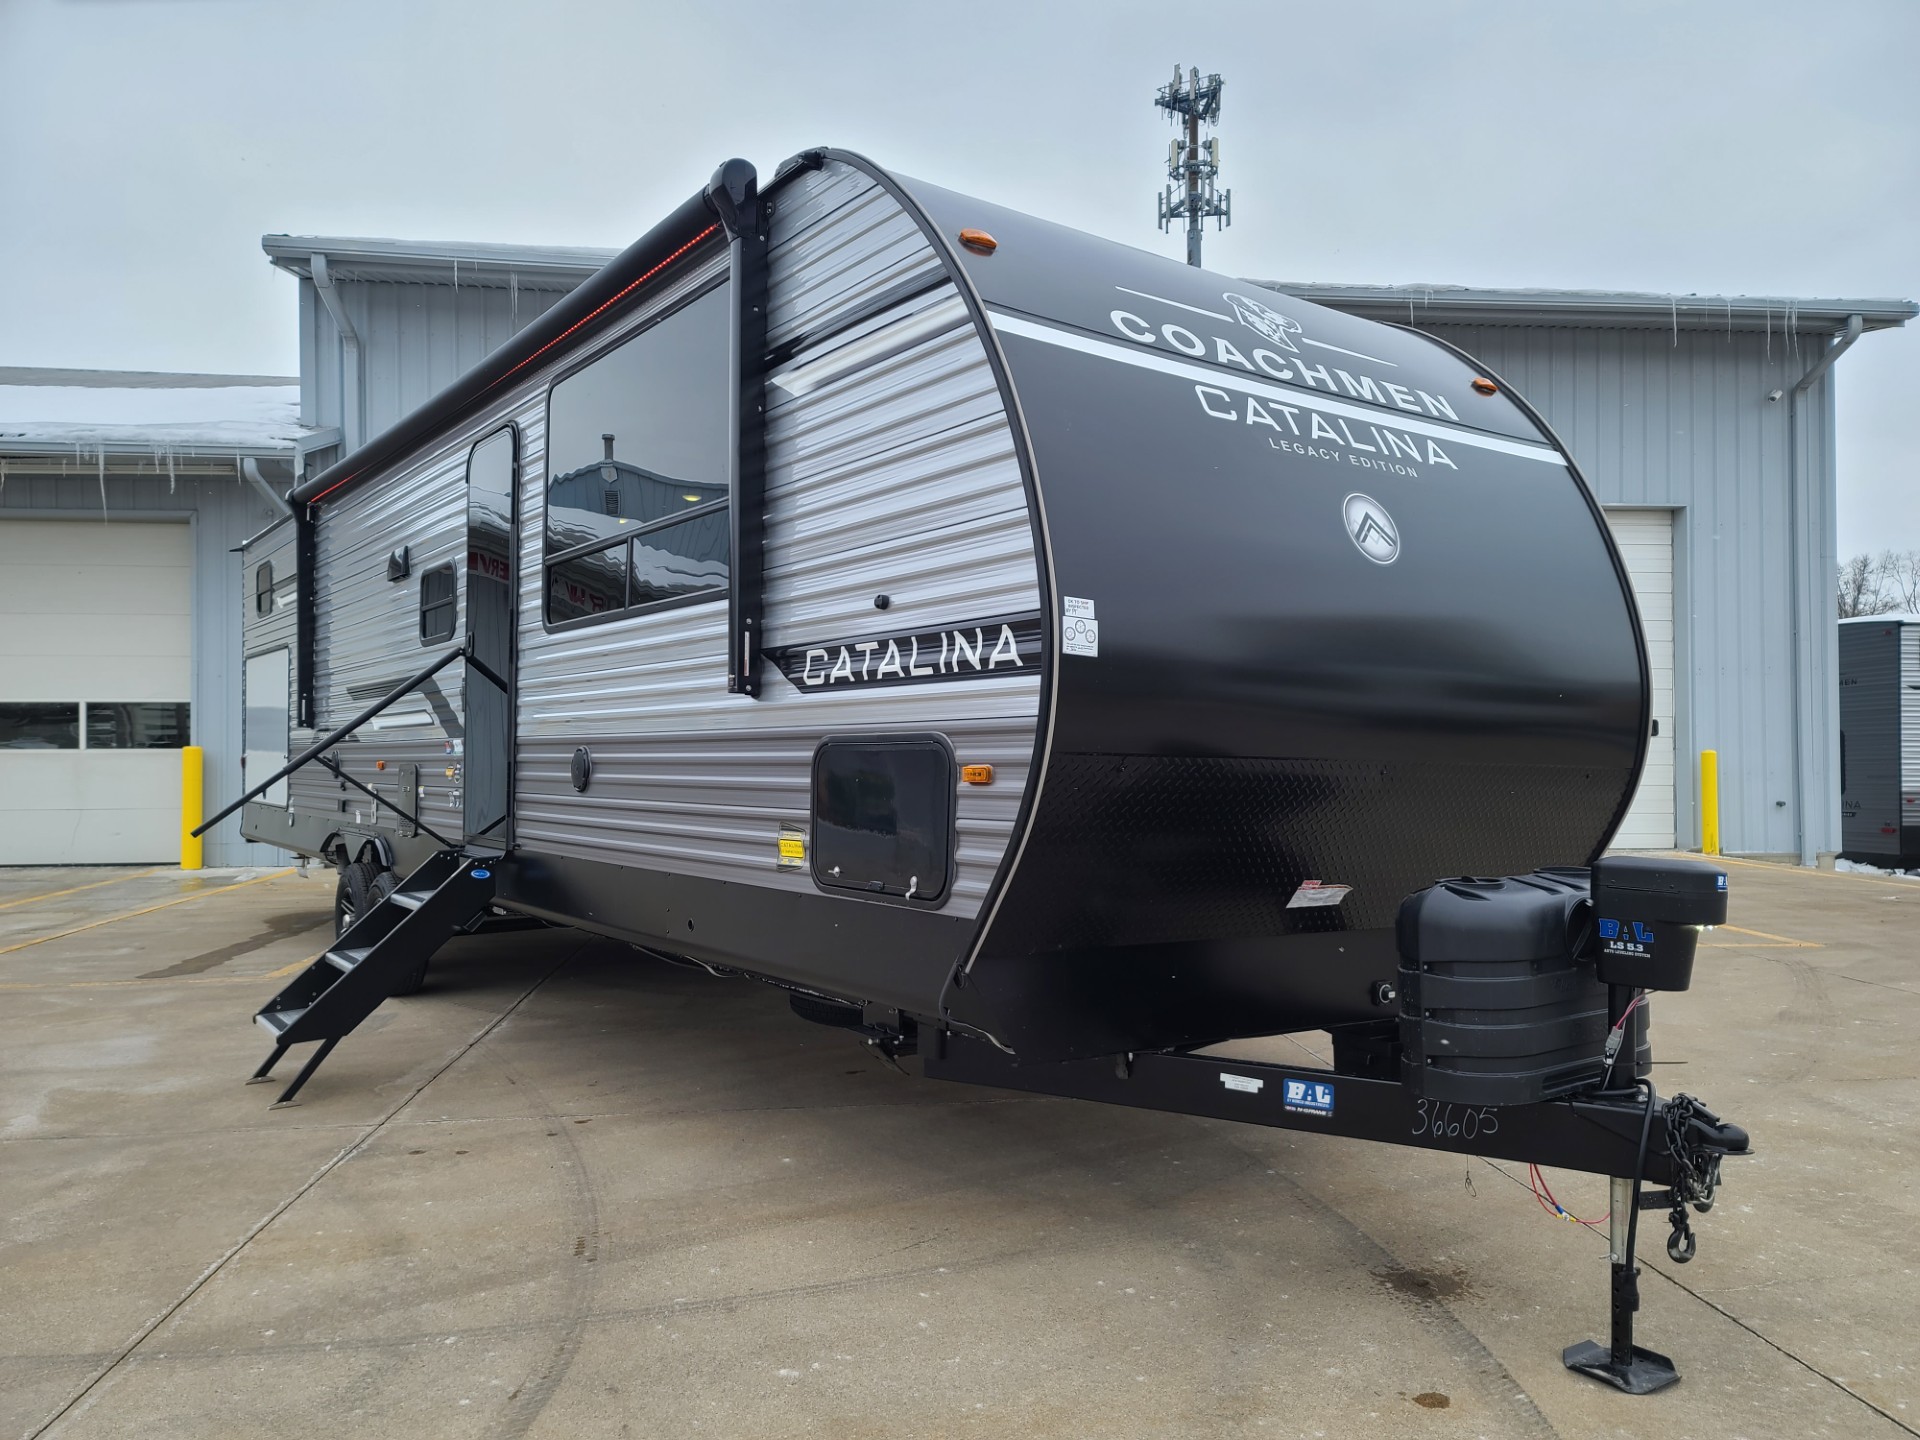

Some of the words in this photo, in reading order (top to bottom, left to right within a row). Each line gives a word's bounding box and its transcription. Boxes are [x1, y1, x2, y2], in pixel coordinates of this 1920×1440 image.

[1110, 310, 1460, 421] COACHMEN
[1194, 384, 1459, 470] CATALINA
[1269, 437, 1340, 461] LEGACY
[1349, 454, 1418, 478] EDITION
[802, 624, 1023, 685] CATALINA
[1599, 918, 1654, 943] BAL
[1610, 941, 1625, 950] LS
[1626, 943, 1644, 952] 5.3
[1288, 1081, 1331, 1104] BAL
[1412, 1098, 1498, 1139] 36605
